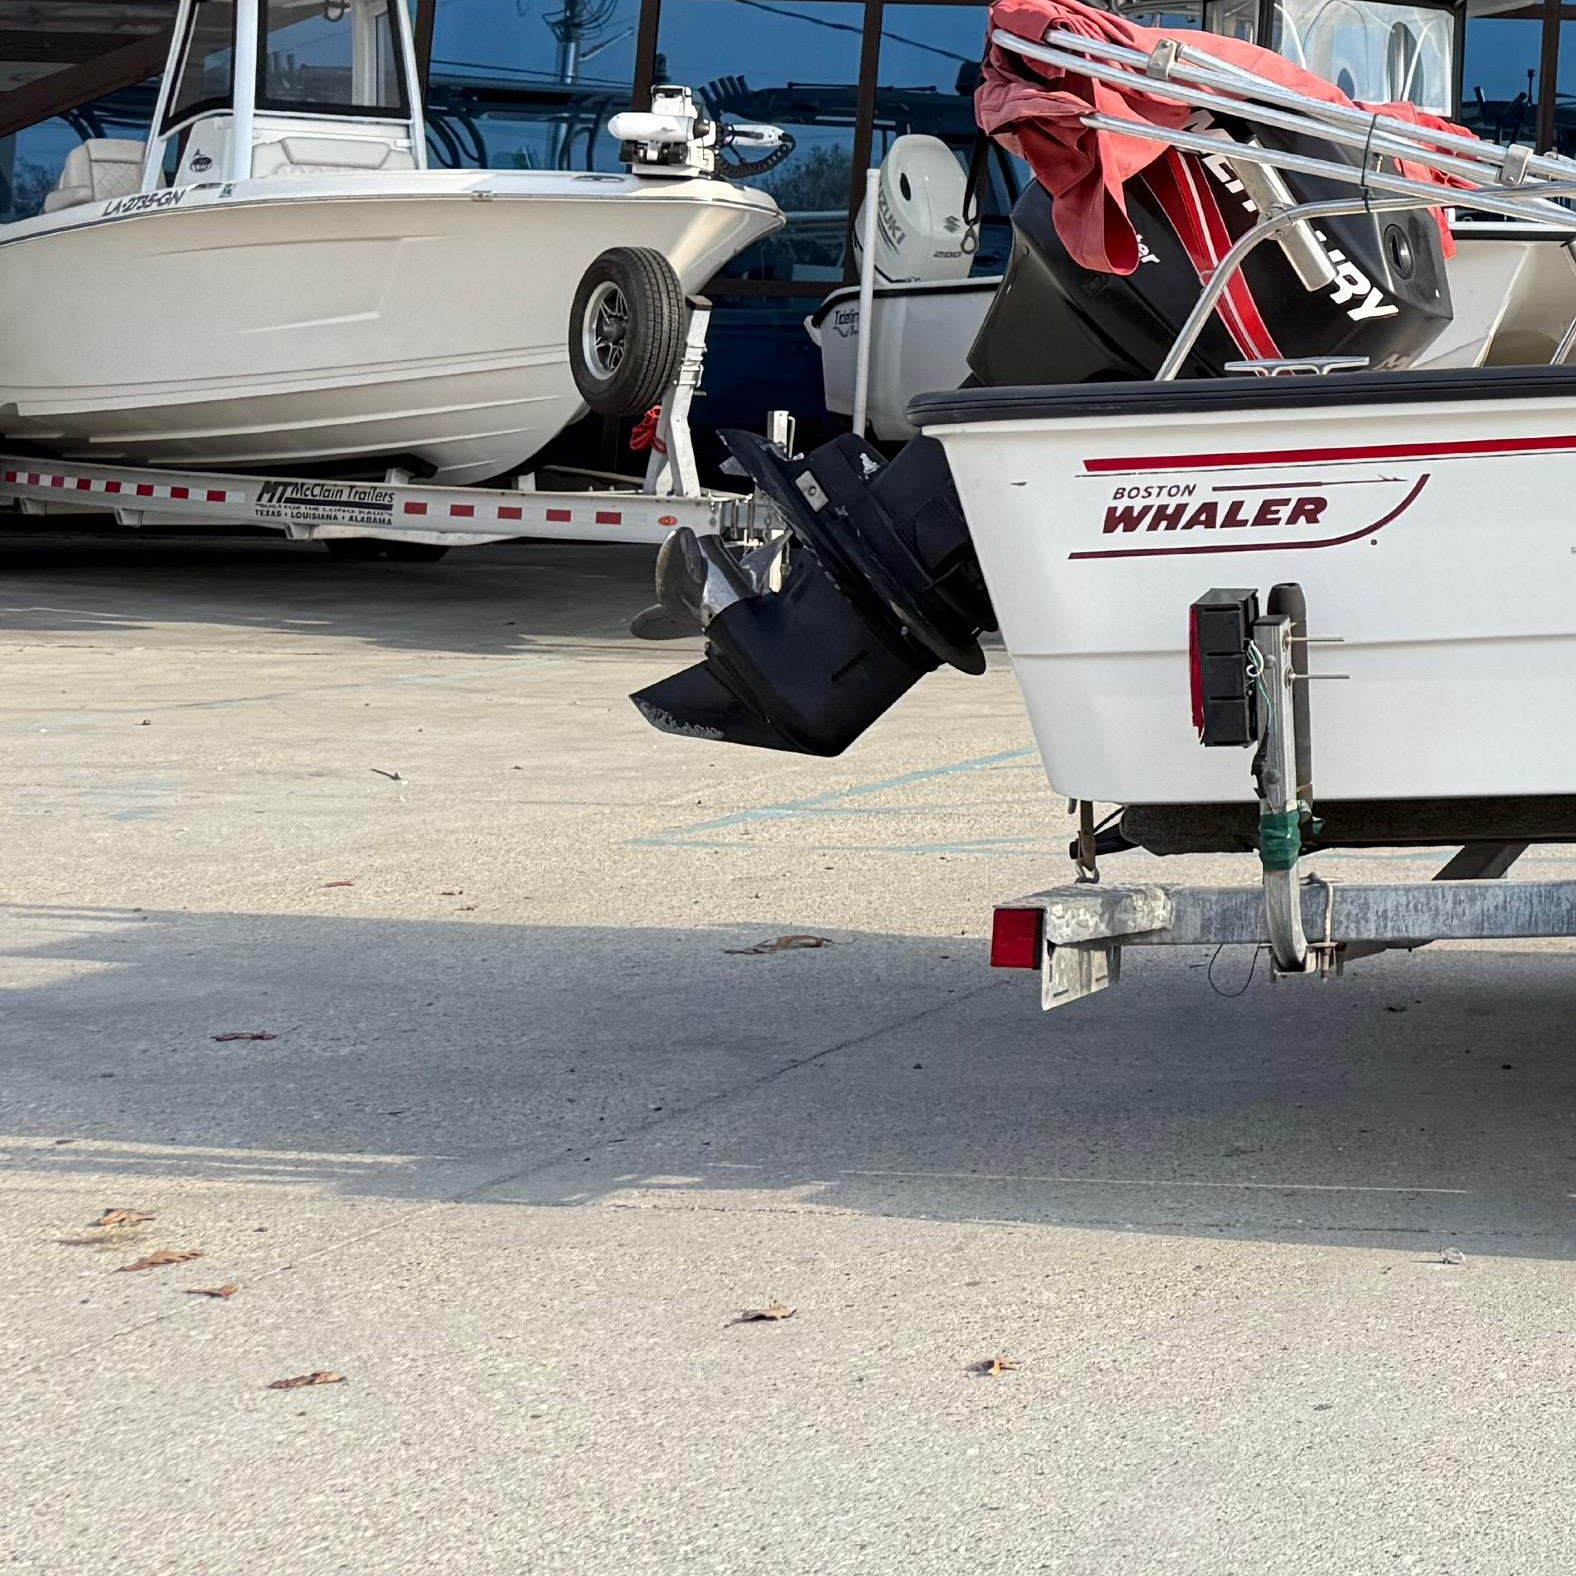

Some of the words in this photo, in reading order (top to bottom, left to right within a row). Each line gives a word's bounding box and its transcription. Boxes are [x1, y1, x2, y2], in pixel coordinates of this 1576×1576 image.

[878, 180, 907, 246] ZUKI
[290, 482, 344, 500] McClain
[347, 485, 396, 503] Trailers
[1112, 483, 1197, 500] BOSTON
[255, 509, 282, 518] TEXAS
[290, 511, 339, 521] LOUISIANA
[348, 515, 393, 525] ALABAMA
[1102, 496, 1328, 534] WHALER
